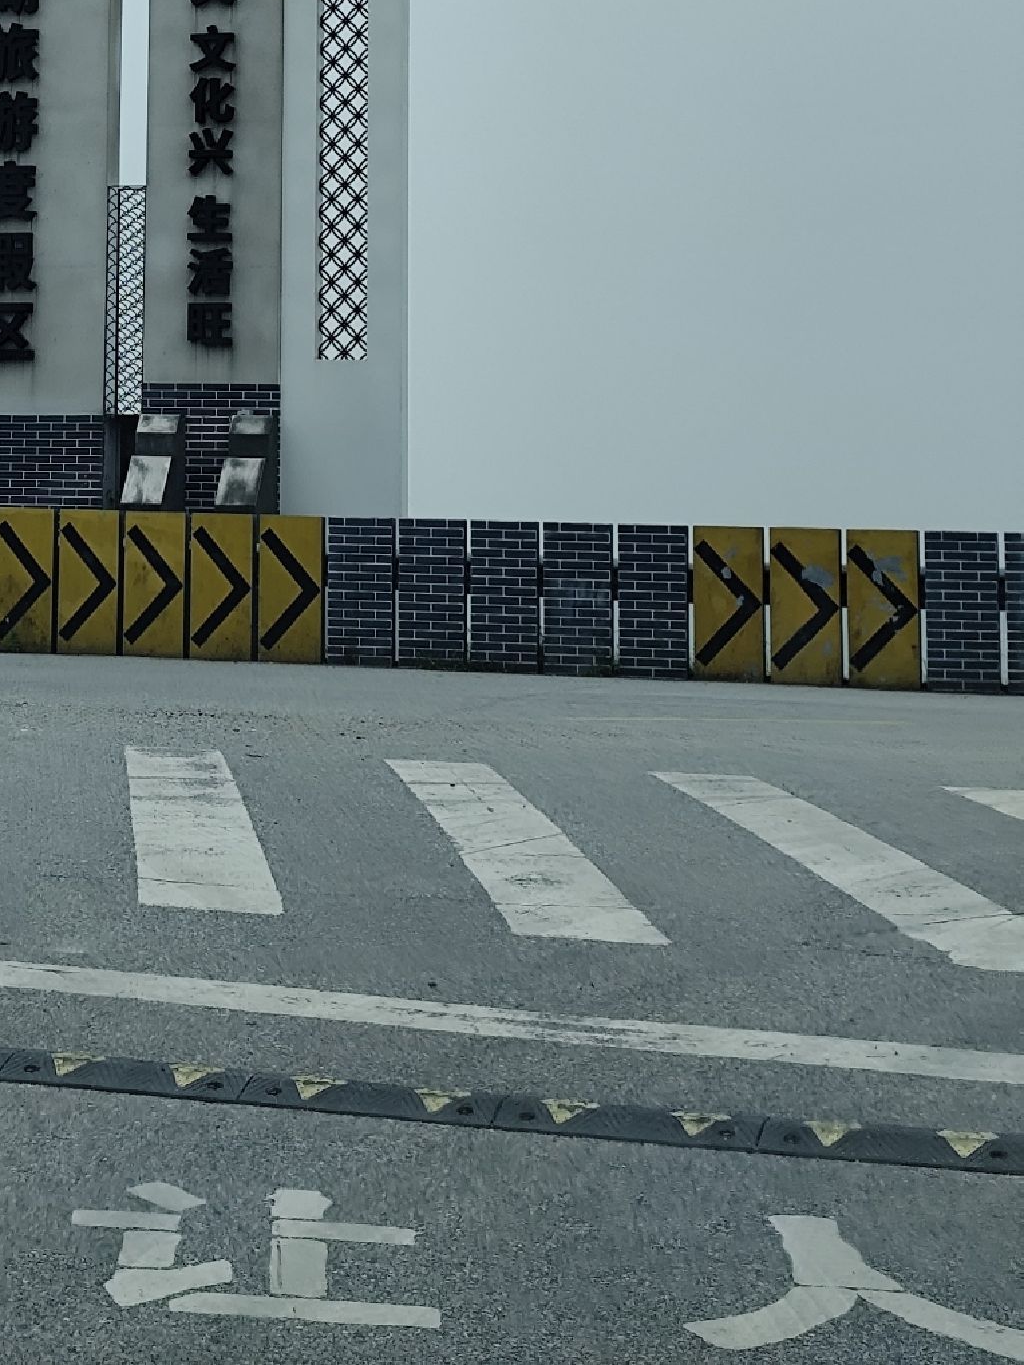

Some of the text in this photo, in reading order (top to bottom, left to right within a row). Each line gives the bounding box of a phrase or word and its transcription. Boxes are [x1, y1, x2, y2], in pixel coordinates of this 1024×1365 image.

[188, 24, 236, 175] 文化兴
[186, 194, 233, 349] 生活旺
